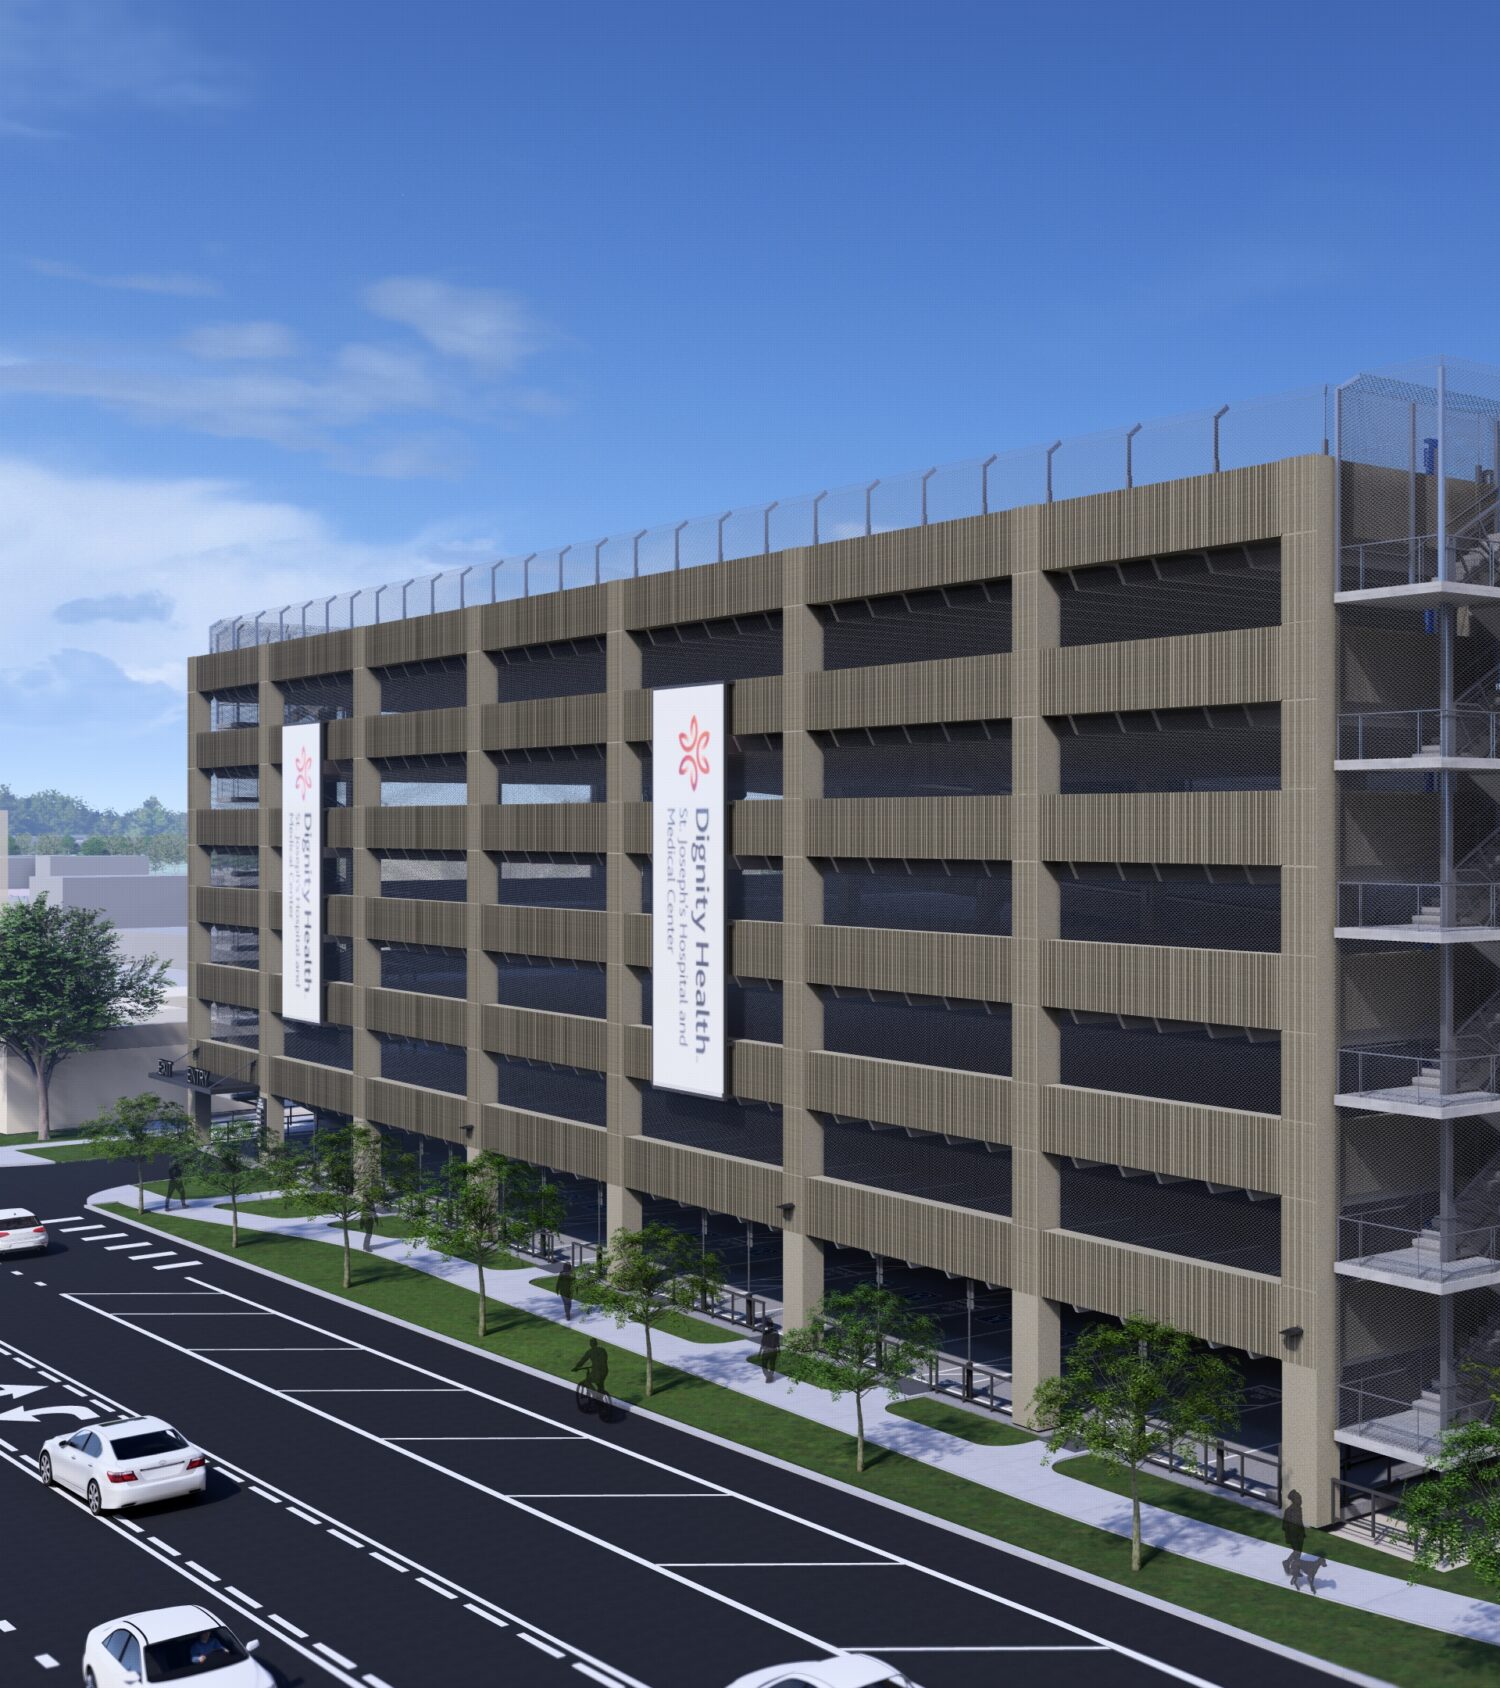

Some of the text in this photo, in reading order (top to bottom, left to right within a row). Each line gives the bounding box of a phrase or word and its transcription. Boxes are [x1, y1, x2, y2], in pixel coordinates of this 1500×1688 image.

[302, 812, 312, 992] Dignity Health
[666, 808, 676, 954] Medical Center
[677, 808, 688, 1046] St. Joseph's Hospital and
[691, 808, 710, 1054] Dignity Health
[187, 1066, 210, 1087] ENTRY
